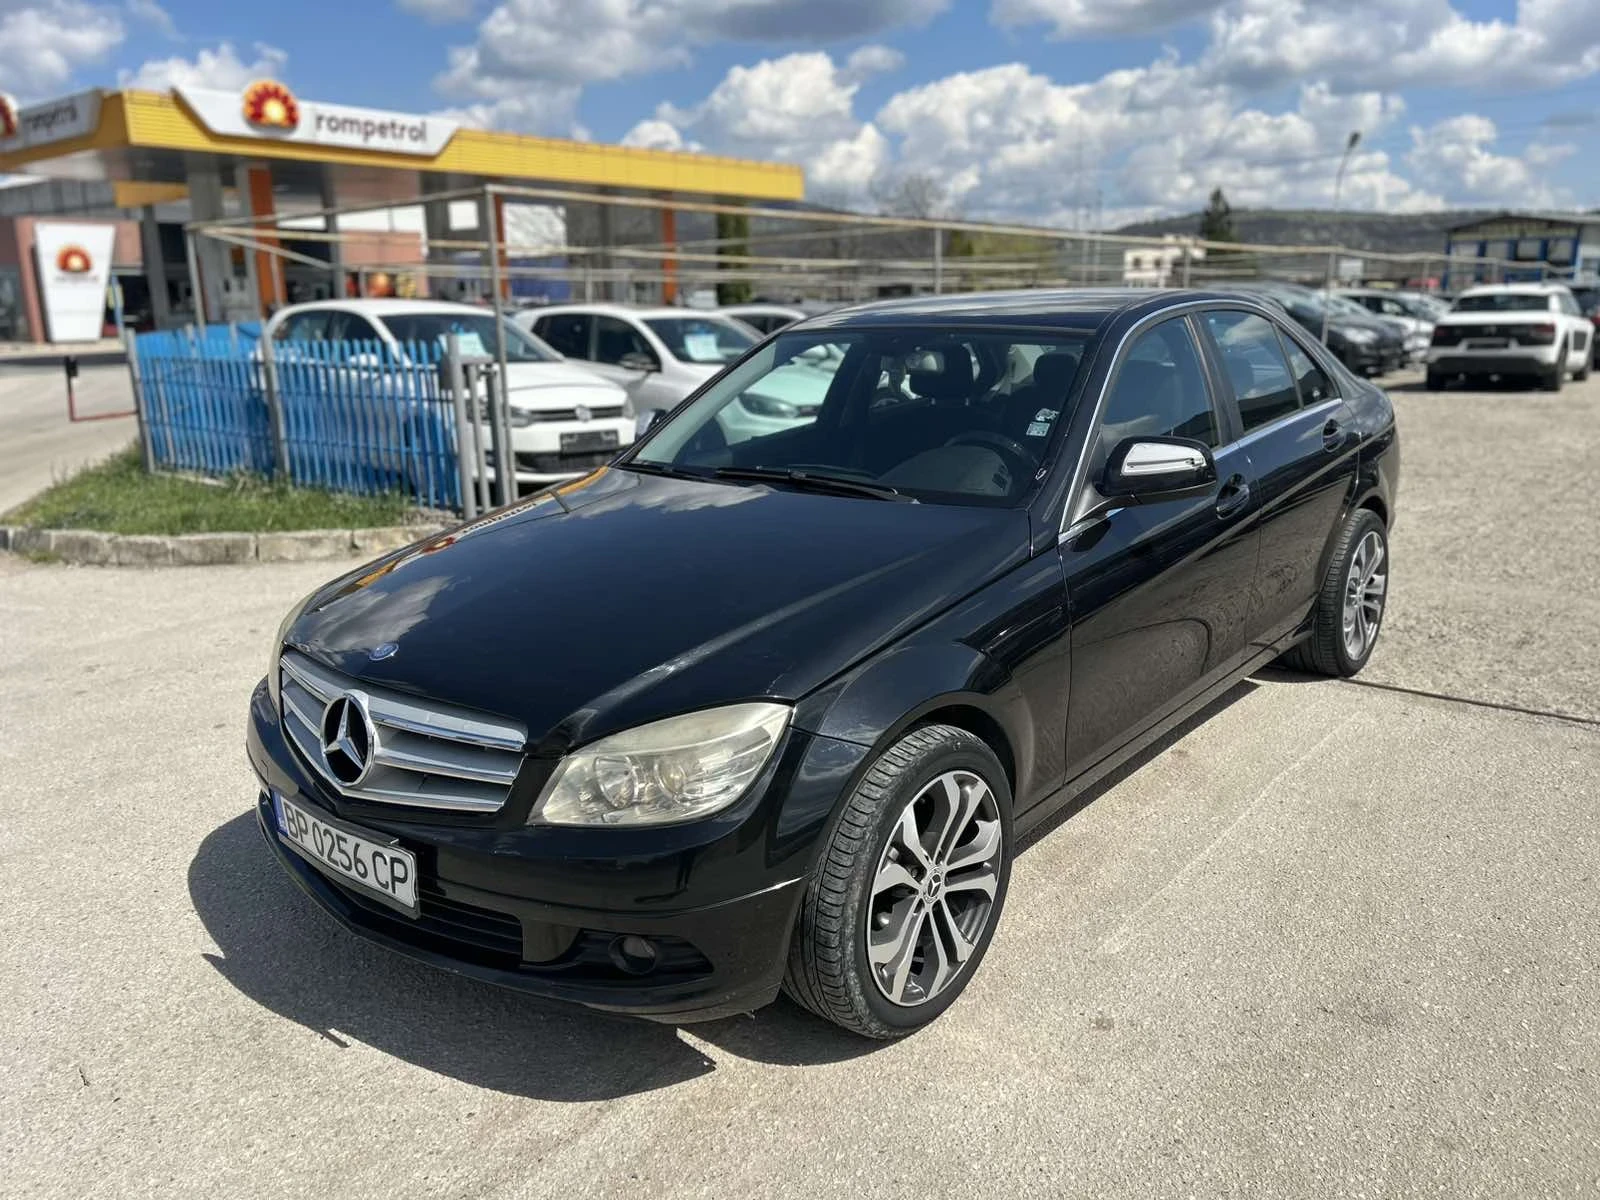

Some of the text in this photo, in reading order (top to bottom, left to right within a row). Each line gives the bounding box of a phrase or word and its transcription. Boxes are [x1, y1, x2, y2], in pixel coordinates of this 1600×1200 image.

[315, 114, 427, 142] rompetrol
[283, 802, 408, 894] BP 0256 CP
